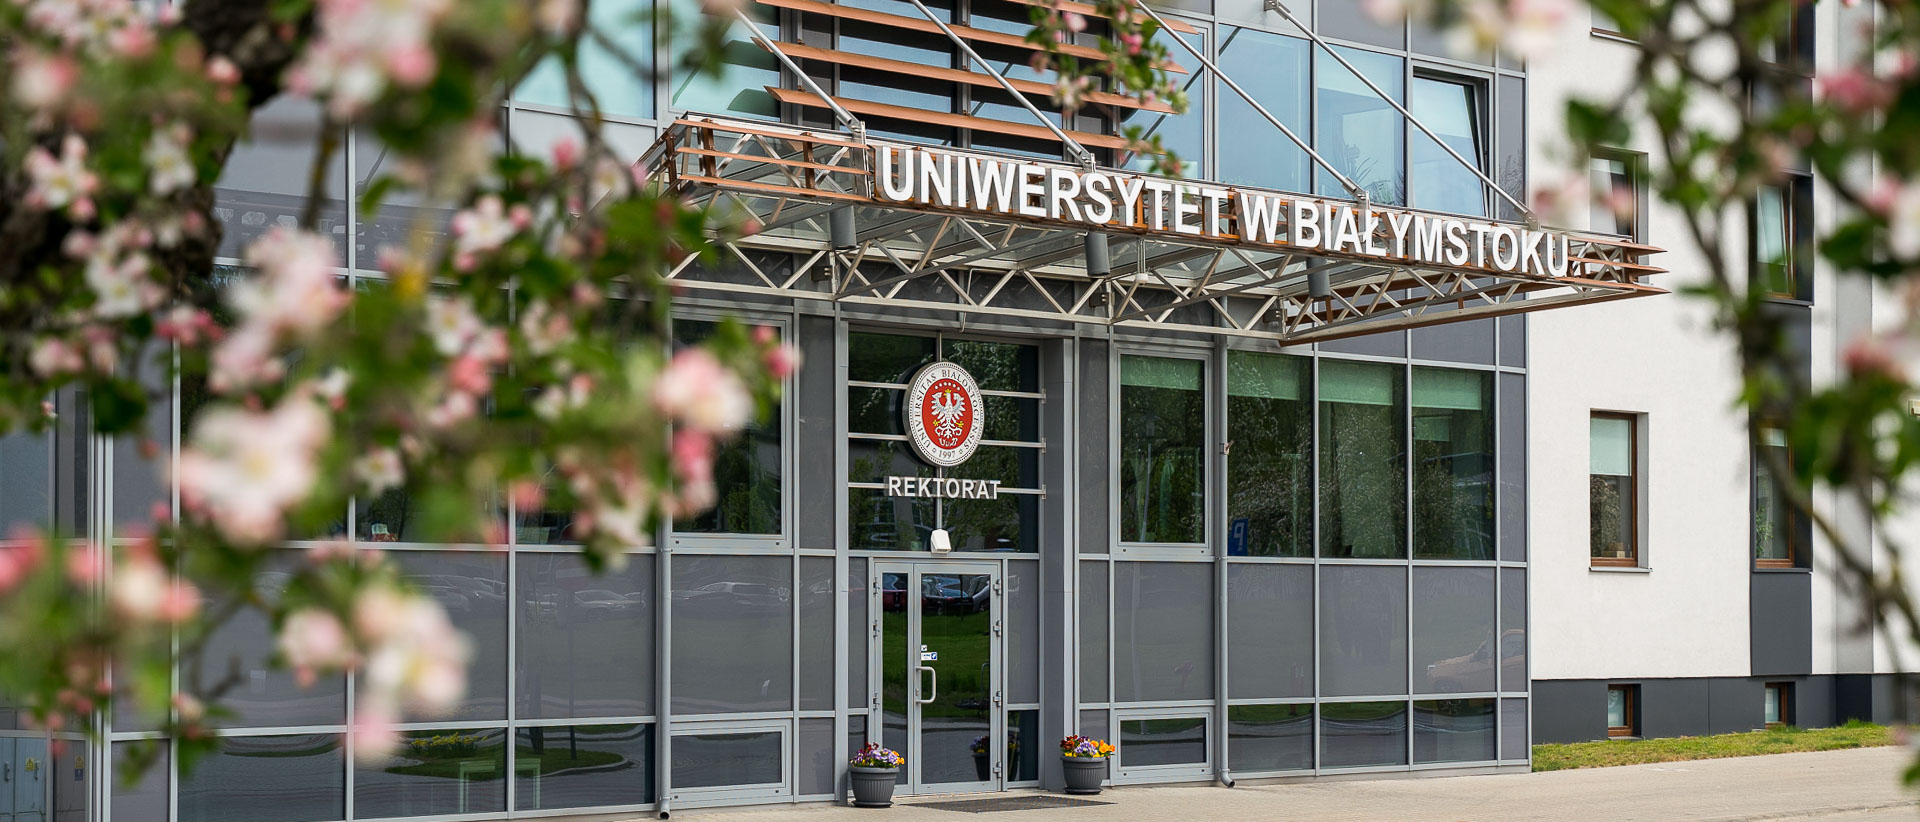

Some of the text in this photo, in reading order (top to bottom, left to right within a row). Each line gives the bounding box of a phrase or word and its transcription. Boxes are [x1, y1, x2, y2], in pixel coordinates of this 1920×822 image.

[881, 146, 1568, 278] UNIWERSYTET W BIAŁYMSTOKU
[914, 369, 979, 450] UNIVERSITAS BIALOSTOCENSIS
[938, 449, 956, 460] 1997
[888, 475, 1002, 500] REKTORAT
